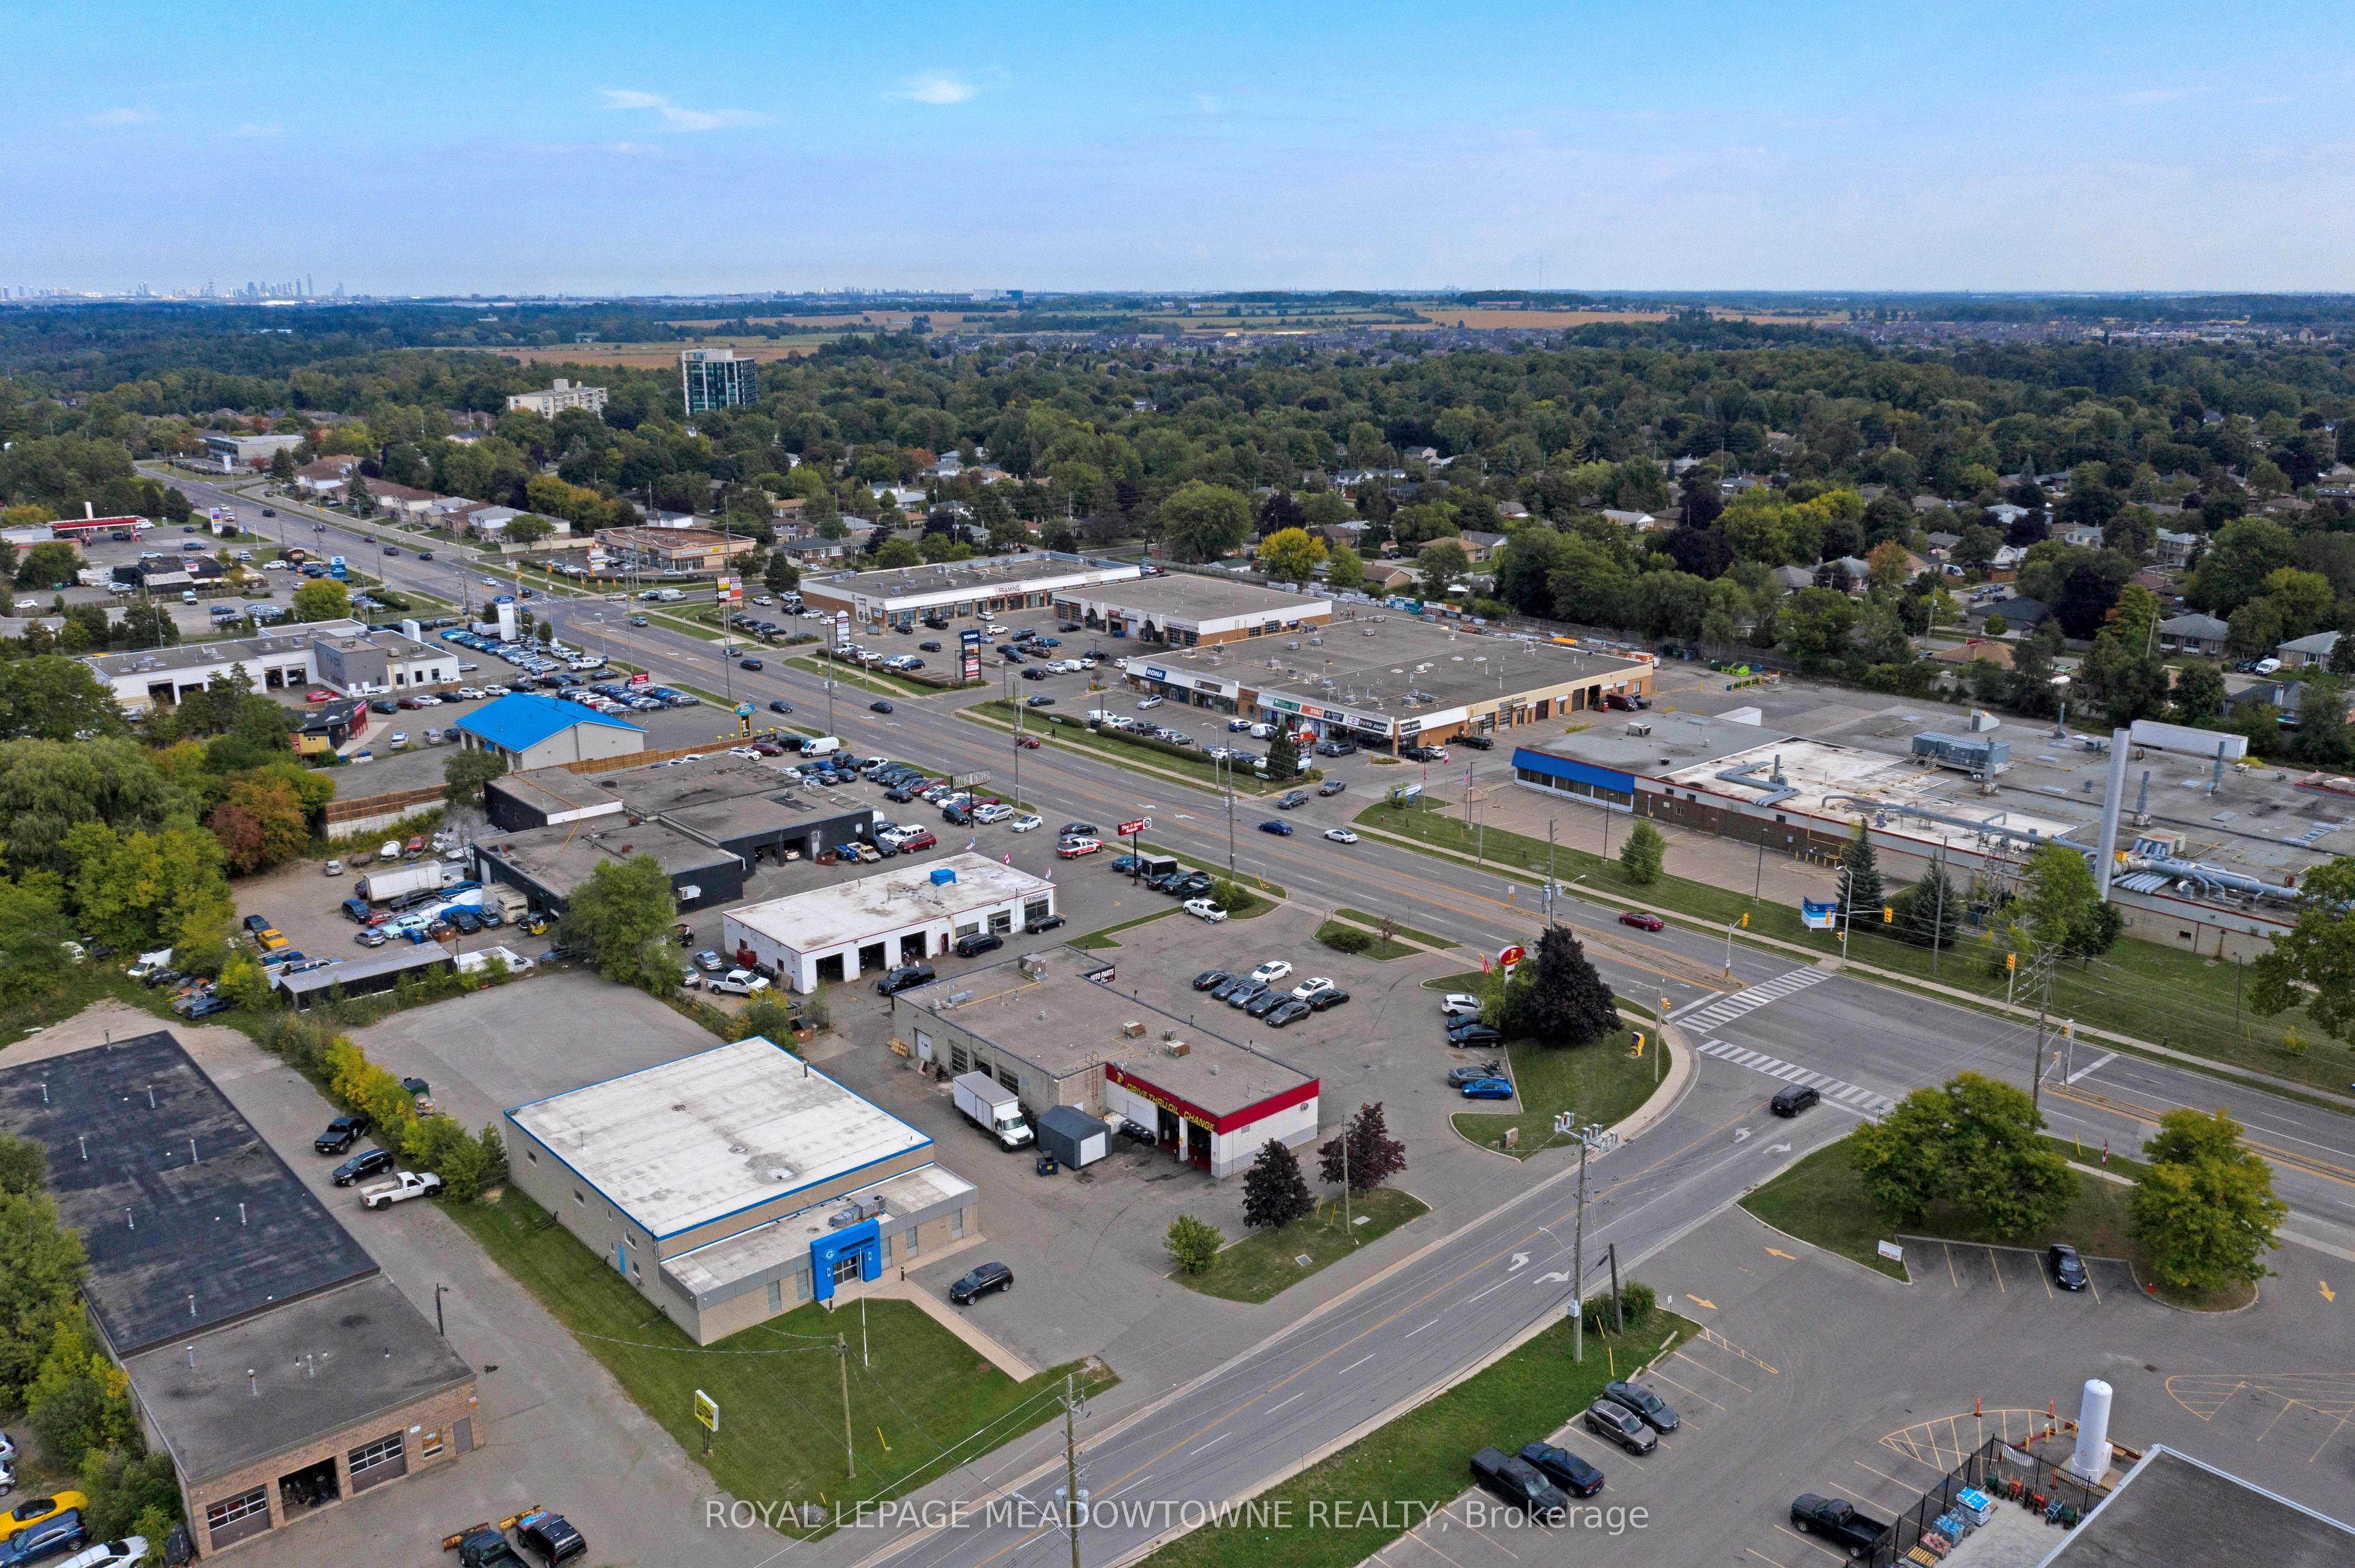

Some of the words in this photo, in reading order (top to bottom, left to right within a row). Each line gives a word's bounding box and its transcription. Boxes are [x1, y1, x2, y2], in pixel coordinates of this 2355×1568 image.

[1146, 668, 1163, 678] RONA
[1101, 968, 1114, 978] PARTS
[1127, 1083, 1148, 1098] DRIVE
[1148, 1094, 1168, 1109] THRU
[1168, 1103, 1179, 1115] OIL
[1183, 1111, 1215, 1131] CHANGE
